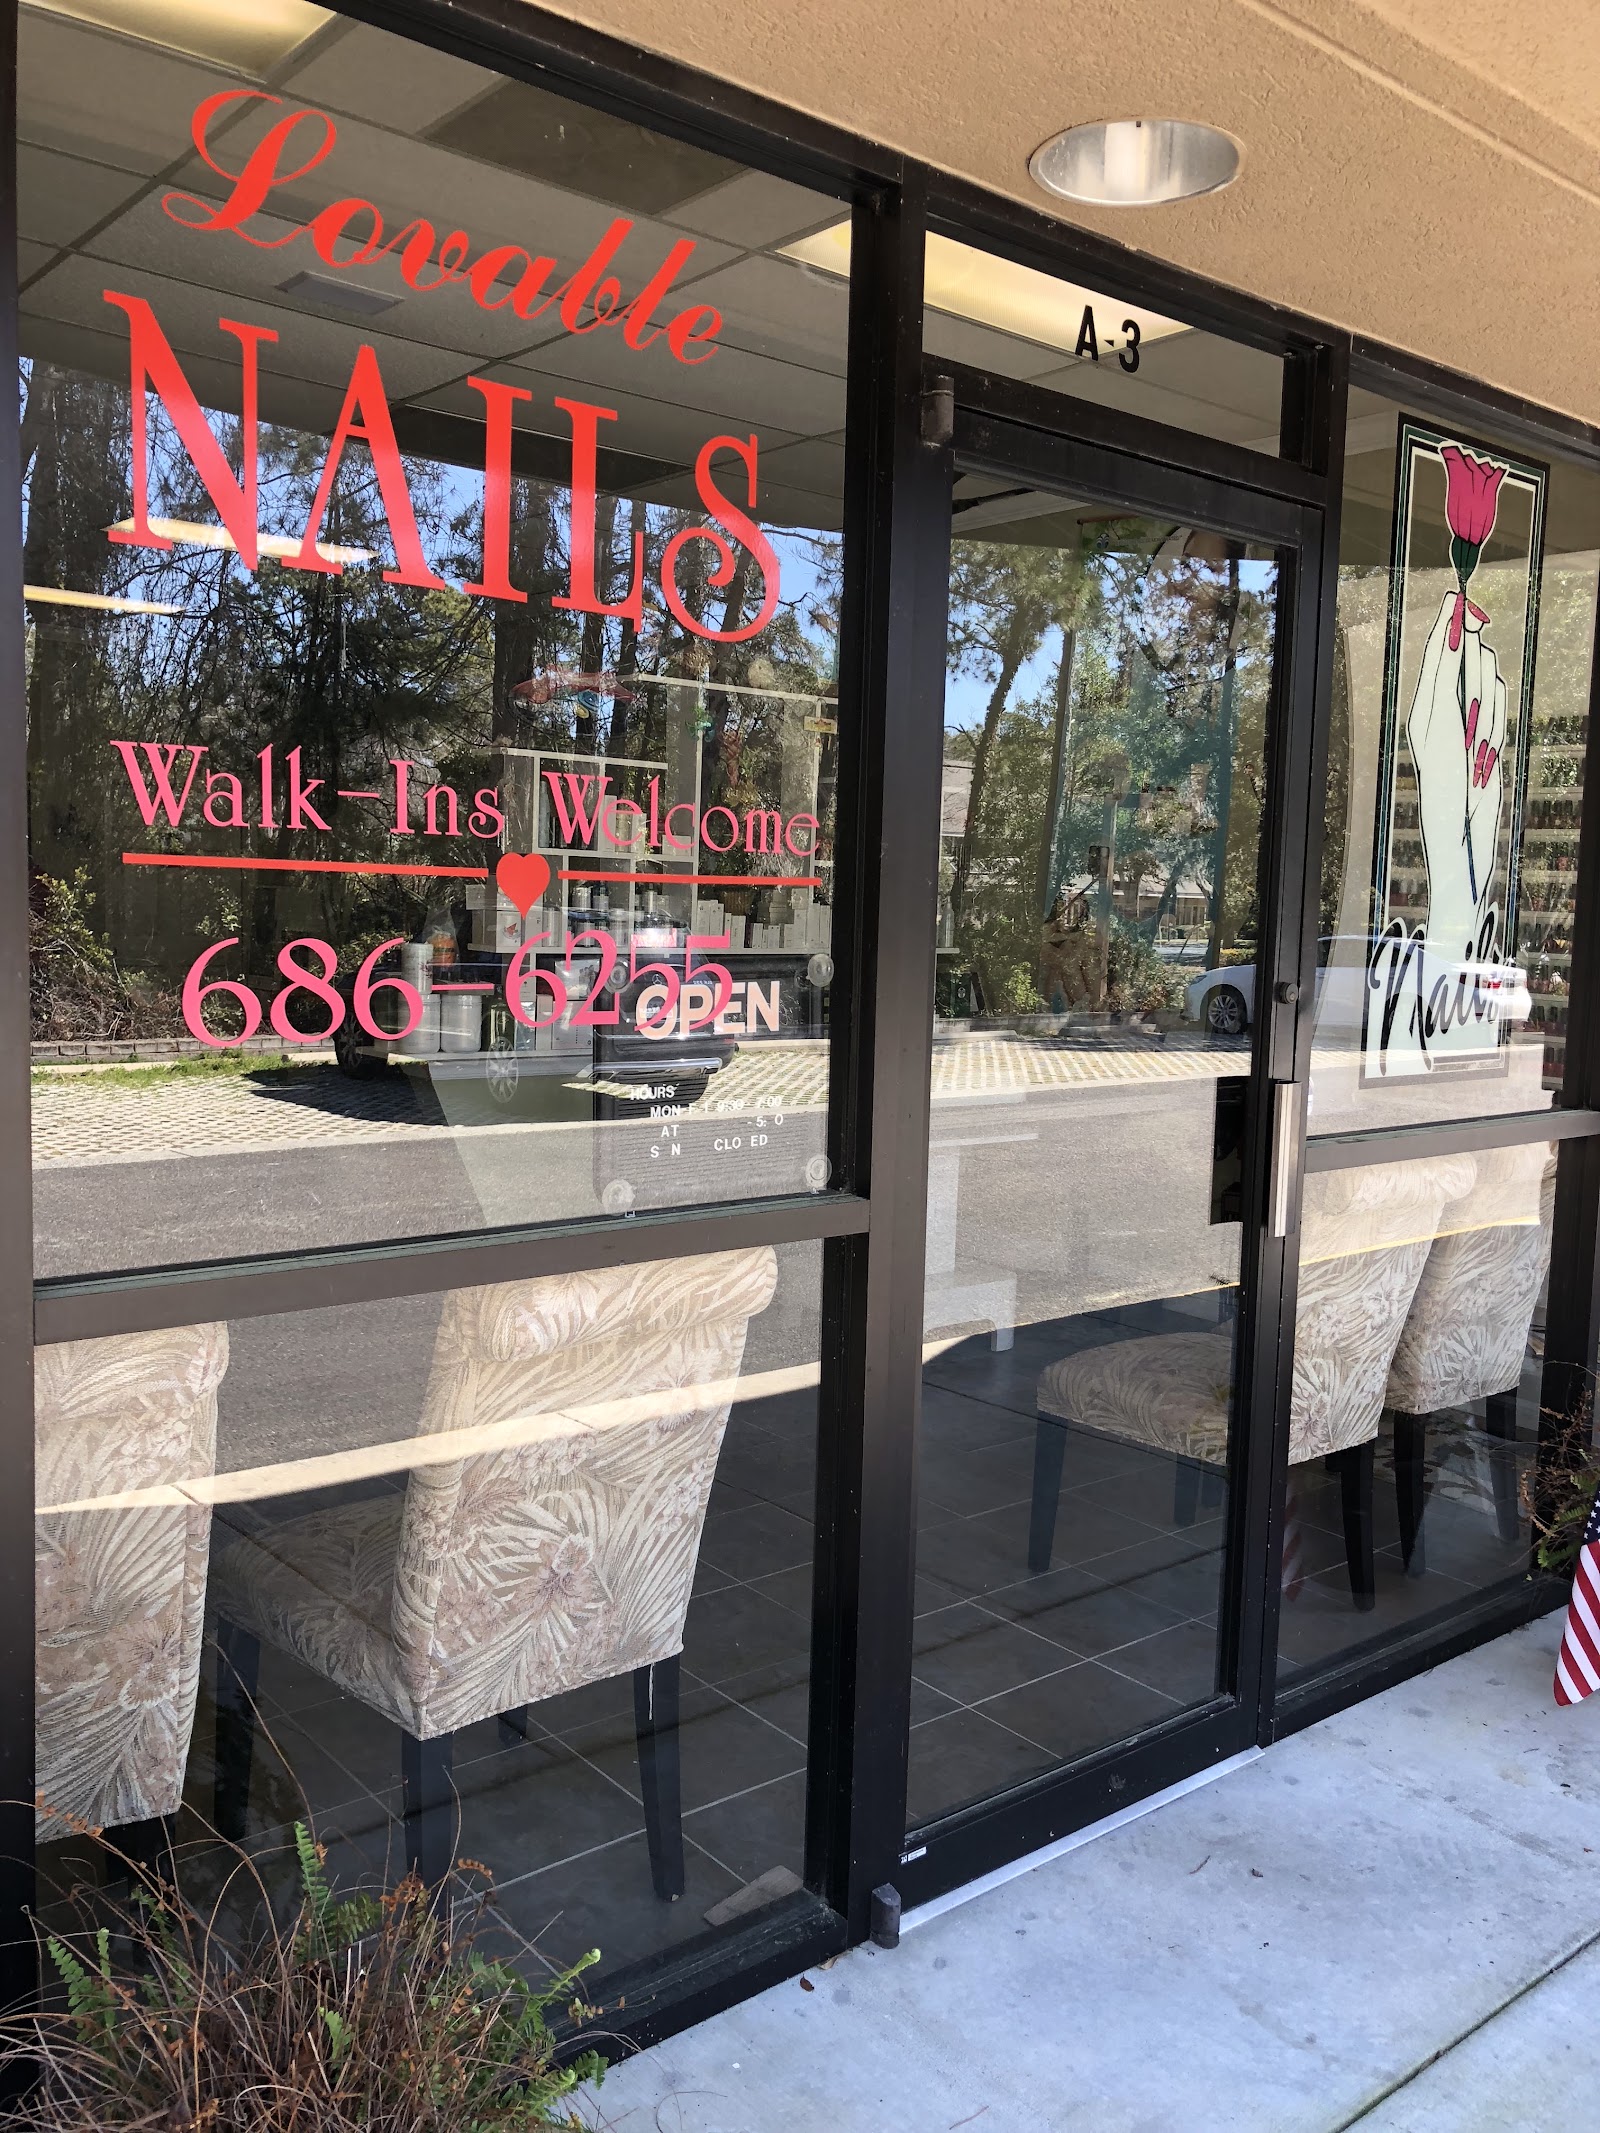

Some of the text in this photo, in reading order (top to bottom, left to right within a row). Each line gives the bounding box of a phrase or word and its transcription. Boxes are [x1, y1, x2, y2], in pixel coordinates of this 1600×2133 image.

[161, 90, 724, 365] Lovable
[1075, 304, 1141, 373] A-3
[103, 289, 781, 642] NAILS
[110, 740, 821, 857] Walk-Ins Welcome
[182, 930, 734, 1047] 686-6255
[635, 980, 780, 1040] OPEN
[630, 1085, 676, 1100] HOURS
